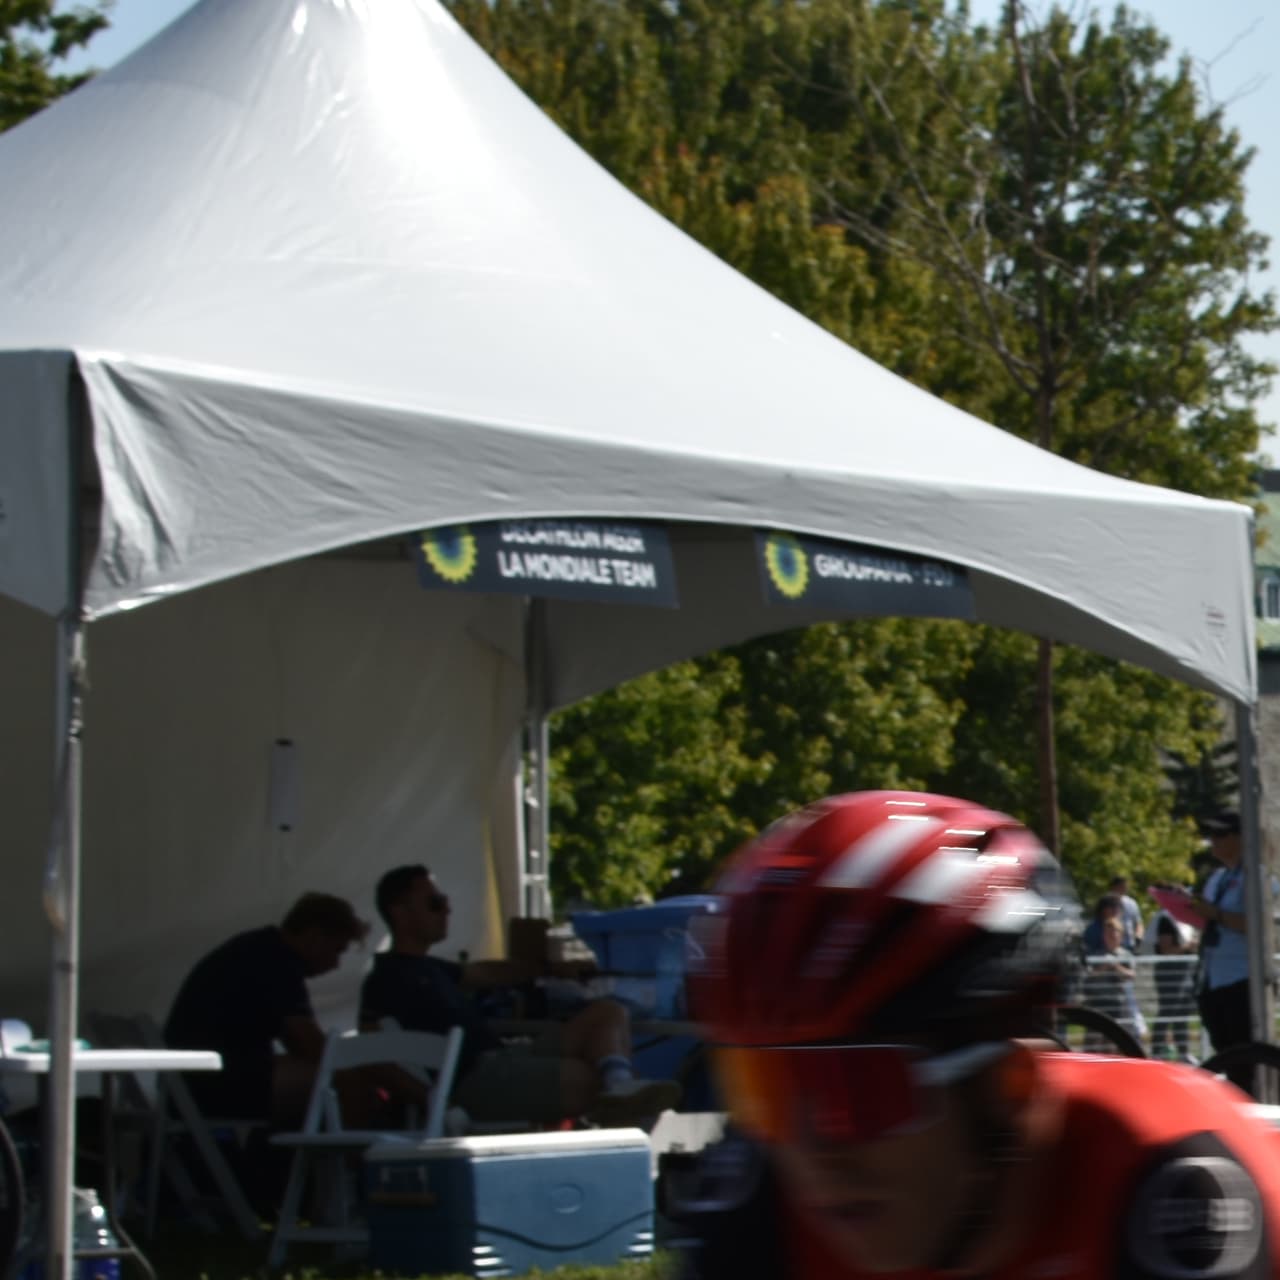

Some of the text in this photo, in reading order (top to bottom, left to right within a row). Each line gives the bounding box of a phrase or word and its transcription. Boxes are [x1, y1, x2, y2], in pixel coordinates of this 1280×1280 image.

[497, 550, 657, 588] LA MONDIALE TEAM
